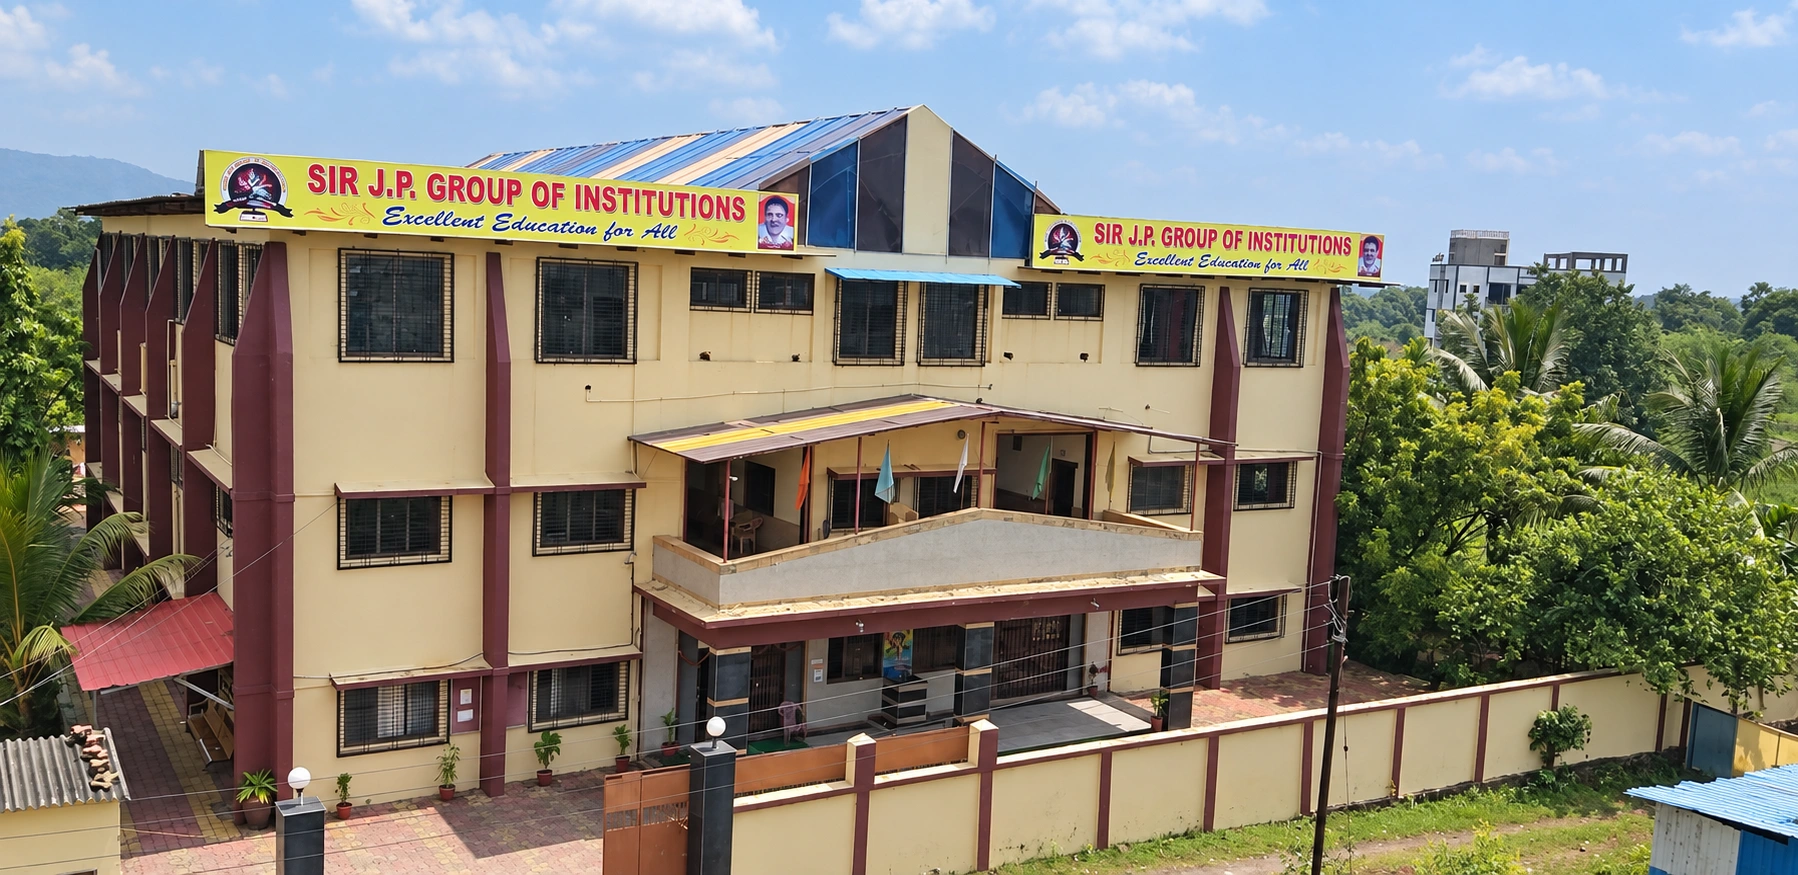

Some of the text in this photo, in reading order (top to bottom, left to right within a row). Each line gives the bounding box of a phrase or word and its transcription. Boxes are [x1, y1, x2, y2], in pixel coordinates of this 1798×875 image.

[307, 163, 359, 196] SIR
[368, 169, 416, 199] J.P.
[426, 173, 522, 207] GROUP
[531, 180, 565, 209] OF
[575, 184, 746, 222] INSTITUTIONS
[382, 206, 677, 241] Excellent Education for All
[1094, 222, 1123, 245] SIR
[1128, 225, 1155, 247] J.P.
[1161, 226, 1218, 249] GROUP
[1222, 229, 1243, 250] OF
[1248, 231, 1352, 256] INSTITUTIONS
[1134, 251, 1309, 273] Excellent Education for All
